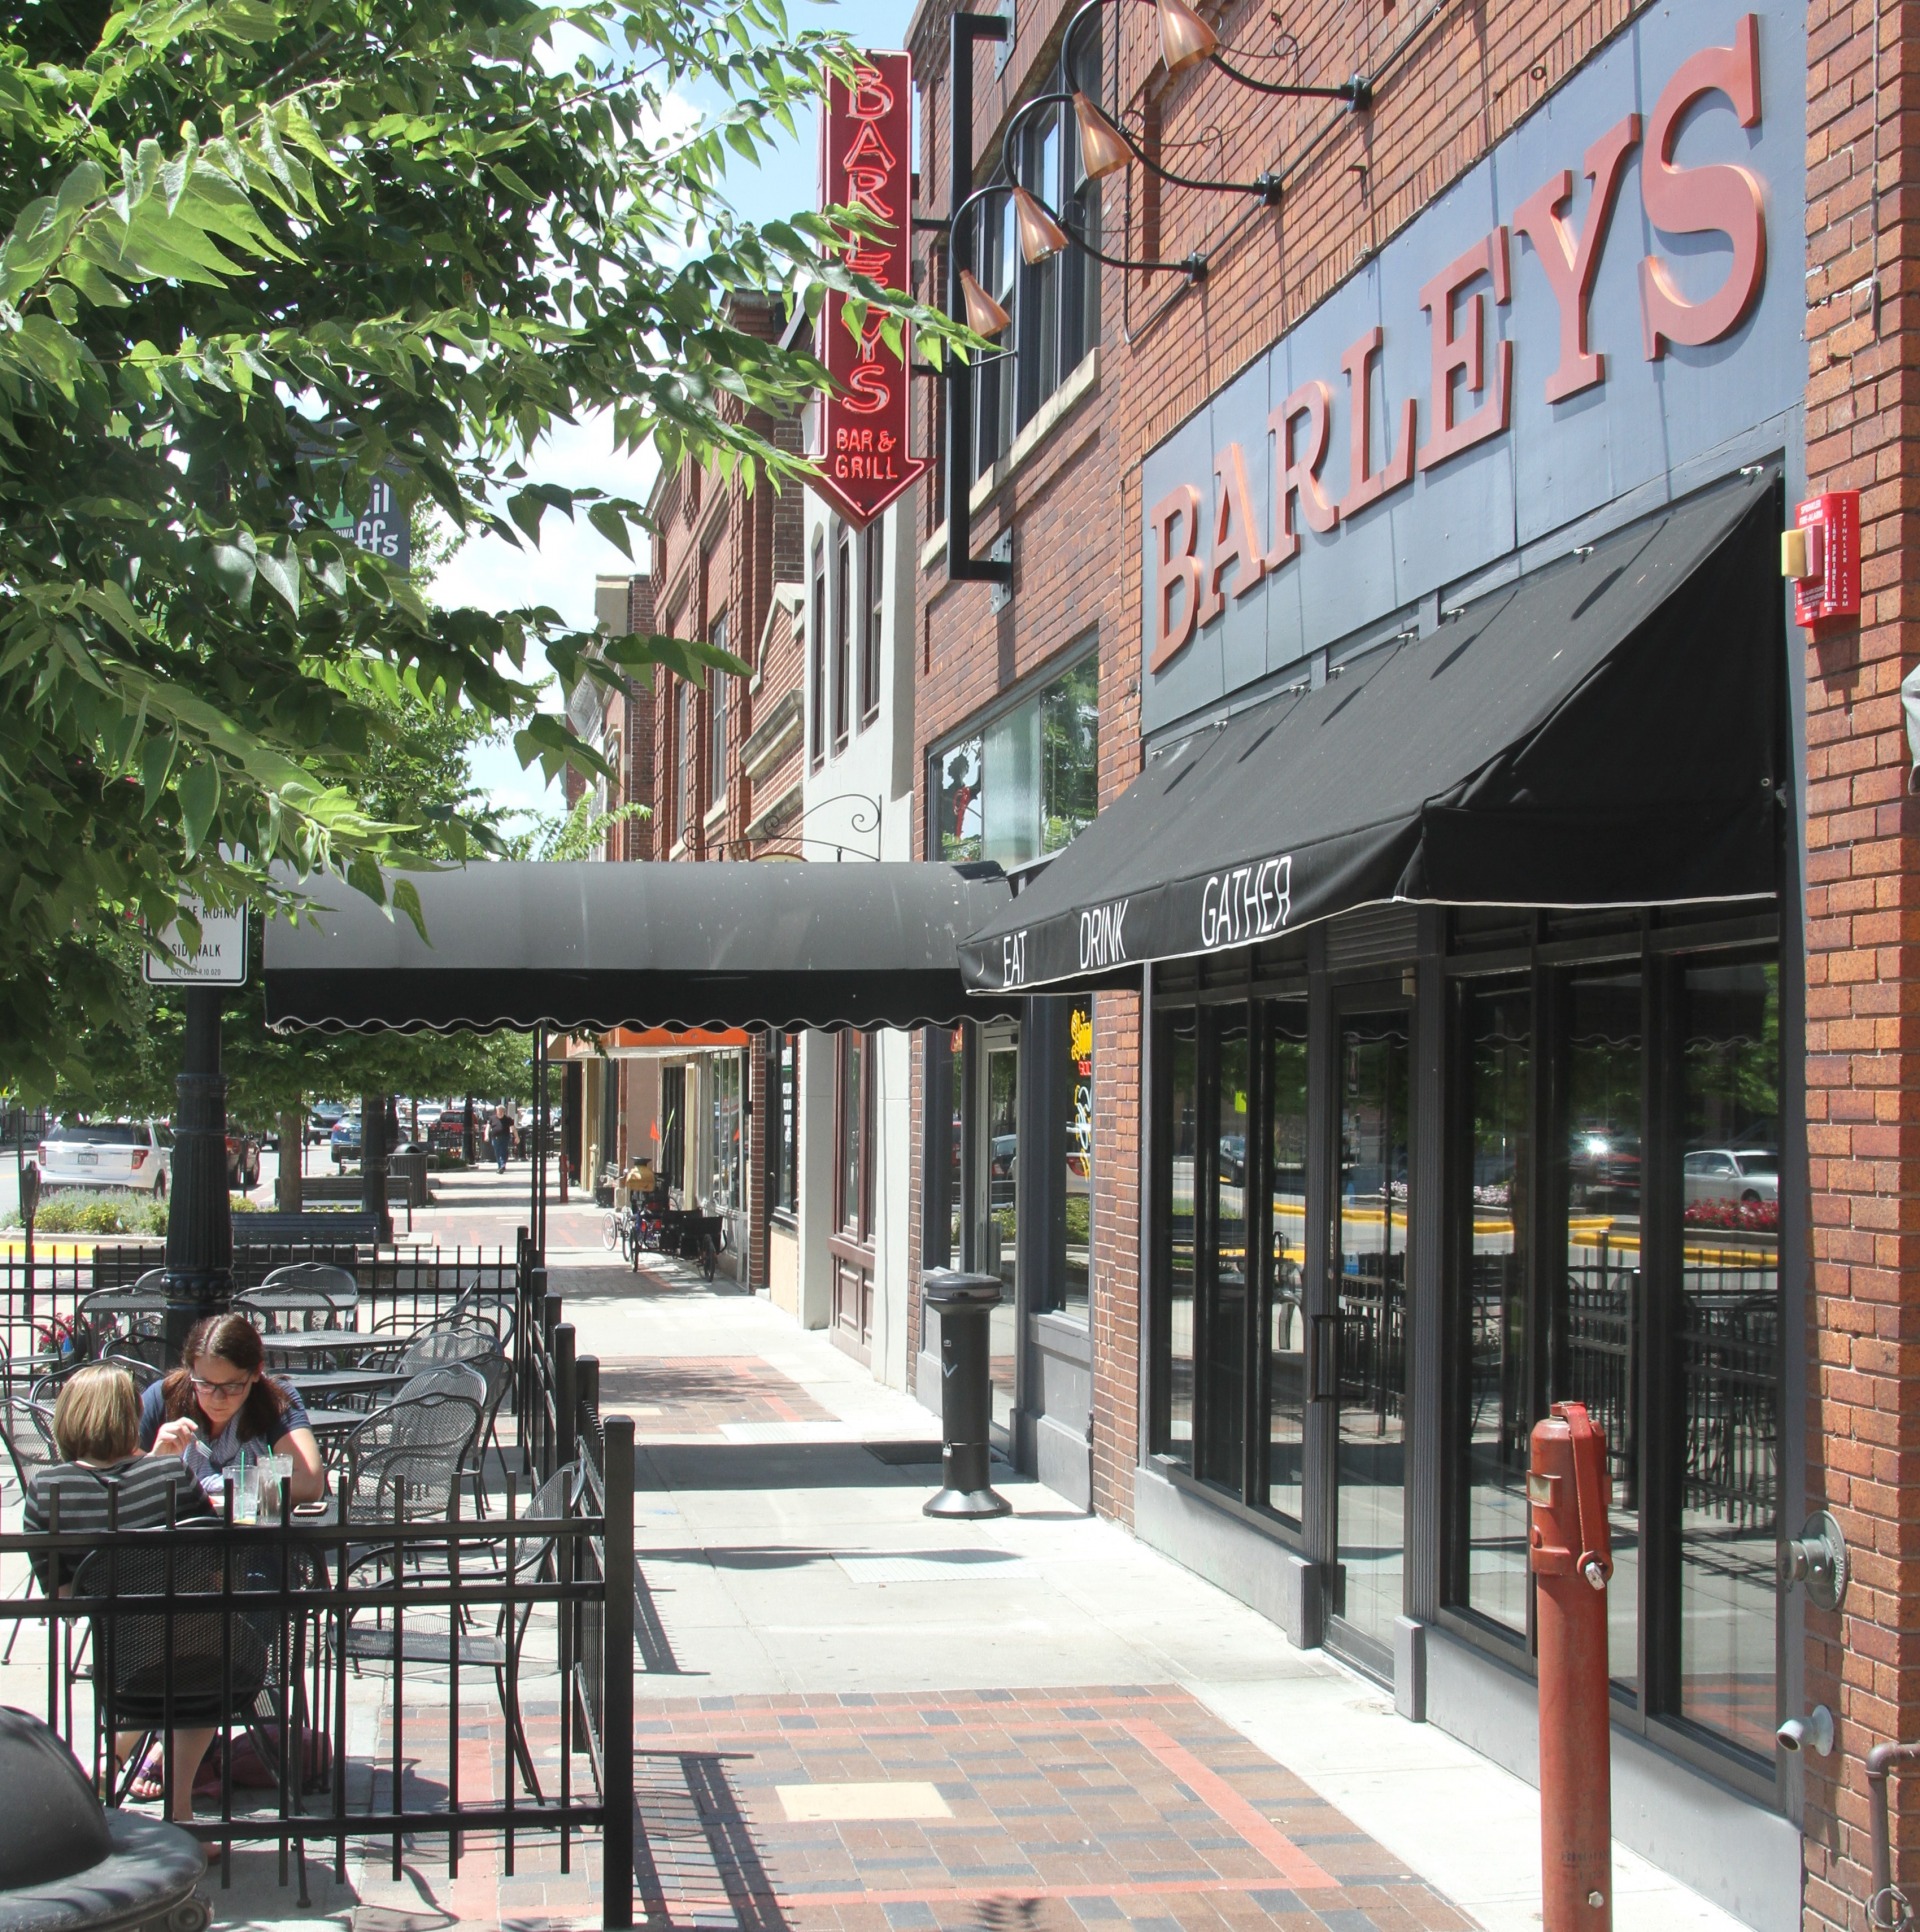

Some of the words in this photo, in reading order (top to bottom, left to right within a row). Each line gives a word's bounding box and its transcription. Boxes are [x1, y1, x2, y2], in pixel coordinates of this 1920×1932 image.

[1150, 14, 1767, 674] BARLEYS
[836, 428, 873, 452] BAR
[877, 430, 896, 452] &
[835, 455, 899, 480] GRILL
[333, 528, 355, 539] OWA
[1003, 931, 1028, 987] EAT
[1079, 899, 1129, 970] DRINK
[1201, 856, 1293, 947] GATHER
